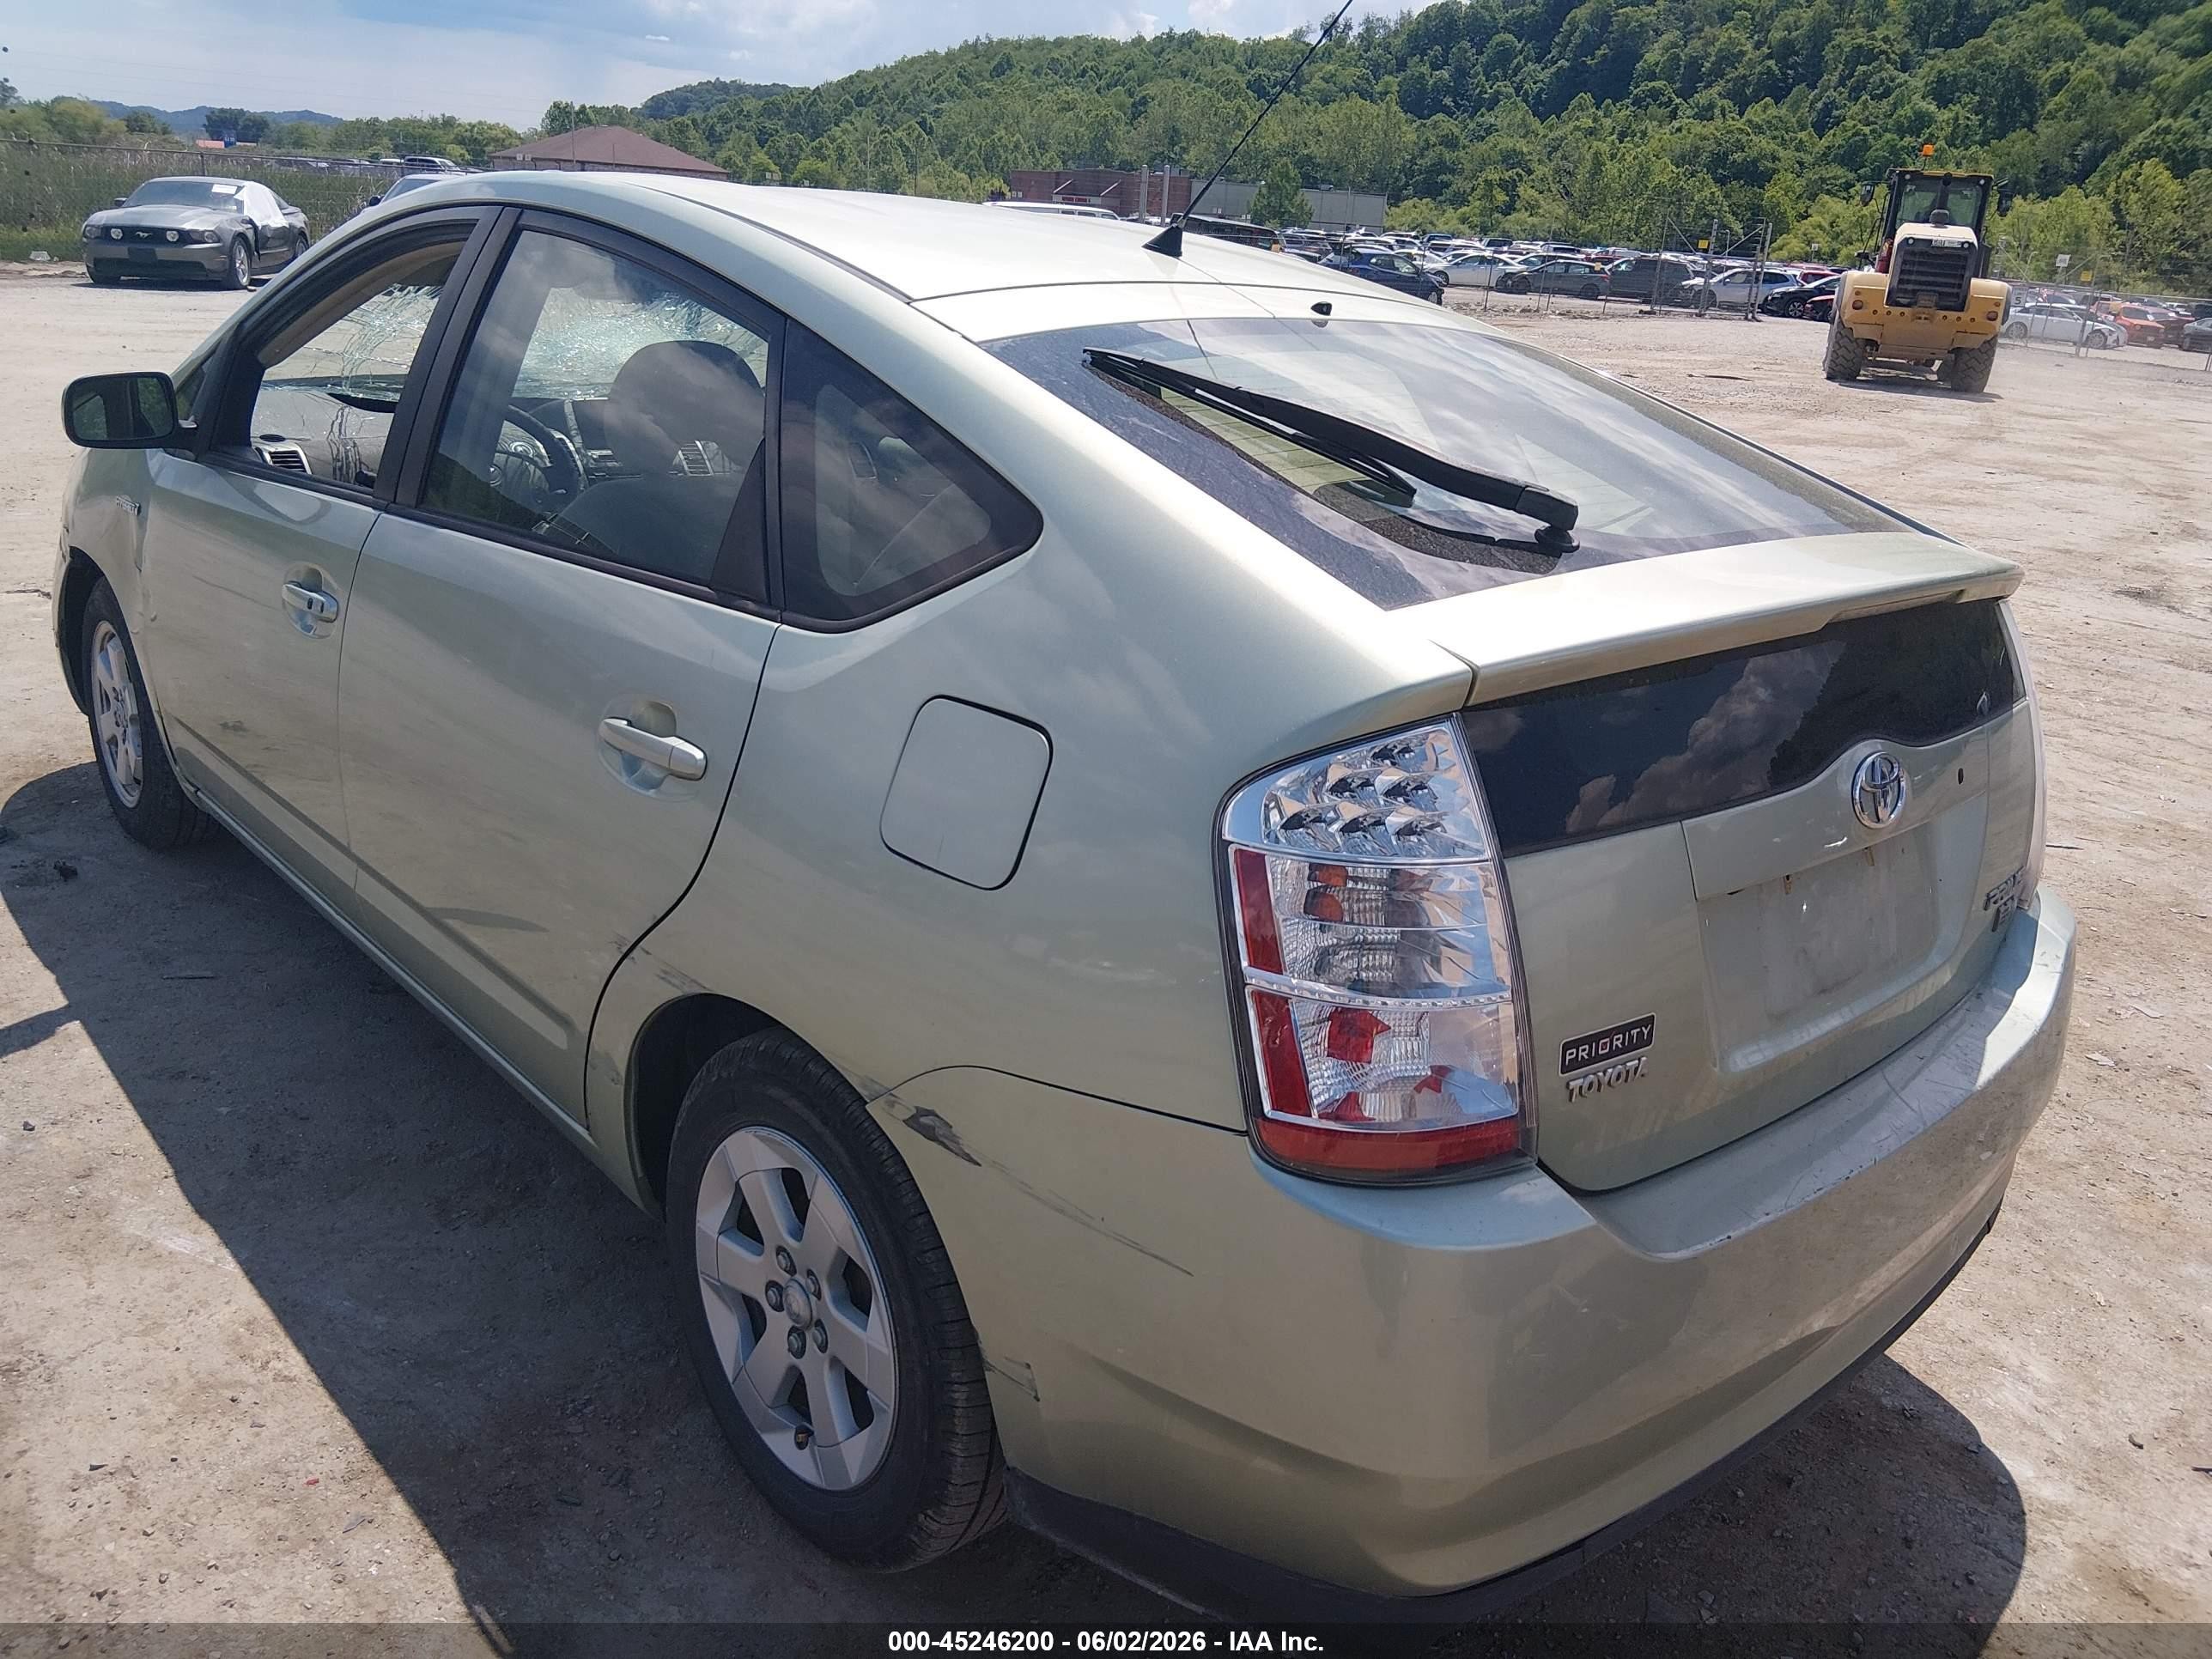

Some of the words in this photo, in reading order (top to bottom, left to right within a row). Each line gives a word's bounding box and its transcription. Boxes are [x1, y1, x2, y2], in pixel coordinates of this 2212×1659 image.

[2014, 296, 2021, 305] 5
[1565, 1024, 1652, 1066] PRIORITY
[1566, 1056, 1647, 1103] TOYOTA
